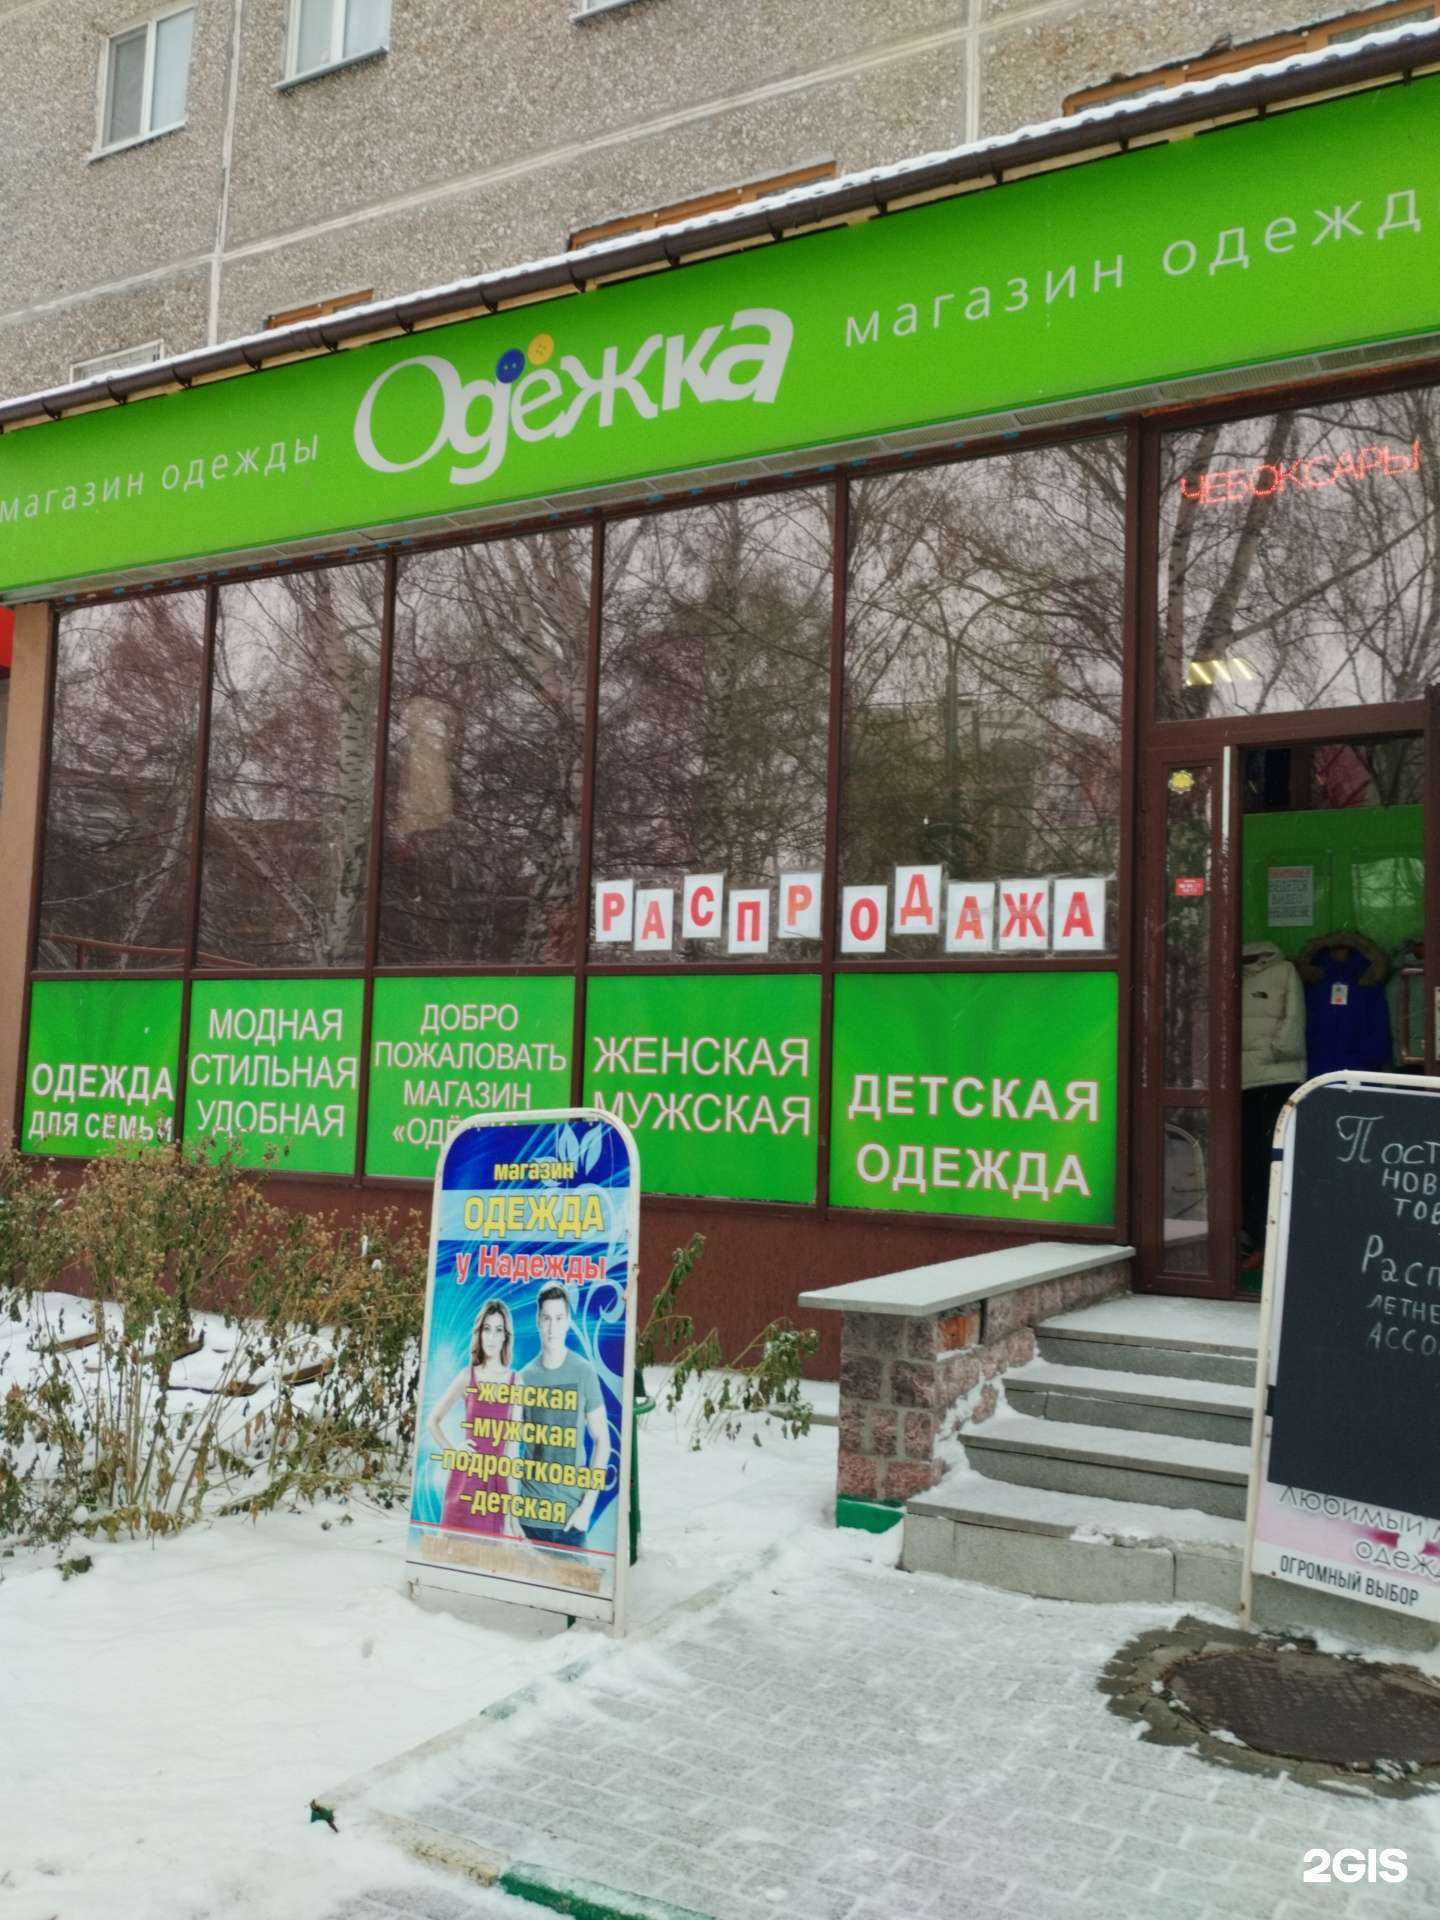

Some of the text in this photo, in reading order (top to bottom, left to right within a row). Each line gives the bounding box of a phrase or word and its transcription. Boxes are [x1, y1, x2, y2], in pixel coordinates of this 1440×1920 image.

[845, 190, 1422, 347] магазин одежд
[0, 433, 319, 523] магазин одежды
[1180, 439, 1421, 504] ЧЕБОКСАРЫ
[601, 873, 1095, 943] РАСПРОДАЖА
[208, 1008, 344, 1046] МОДНАЯ
[420, 1004, 519, 1036] ДОБРО
[190, 1054, 357, 1090] СТИЛЬНАЯ
[375, 1042, 567, 1072] ПОЖАЛОВАТЬ
[592, 1036, 811, 1078] ЖЕНСКАЯ
[31, 1063, 174, 1105] ОДЕЖДА
[403, 1080, 532, 1111] МАГАЗИН
[848, 1074, 1100, 1123] ДЕТСКАЯ
[28, 1111, 174, 1143] ДЛЯ СЕМЬИ
[197, 1100, 346, 1138] УДОБНАЯ
[593, 1091, 811, 1137] МУЖСКАЯ
[494, 1162, 575, 1182] магазин
[856, 1143, 1091, 1202] ОДЕЖДА
[463, 1195, 605, 1239] ОДЕЖДА
[456, 1245, 608, 1286] у Надежды
[1280, 1554, 1420, 1607] ОГРОМНЫЙ ВЫБОР
[1355, 1541, 1440, 1579] одеж
